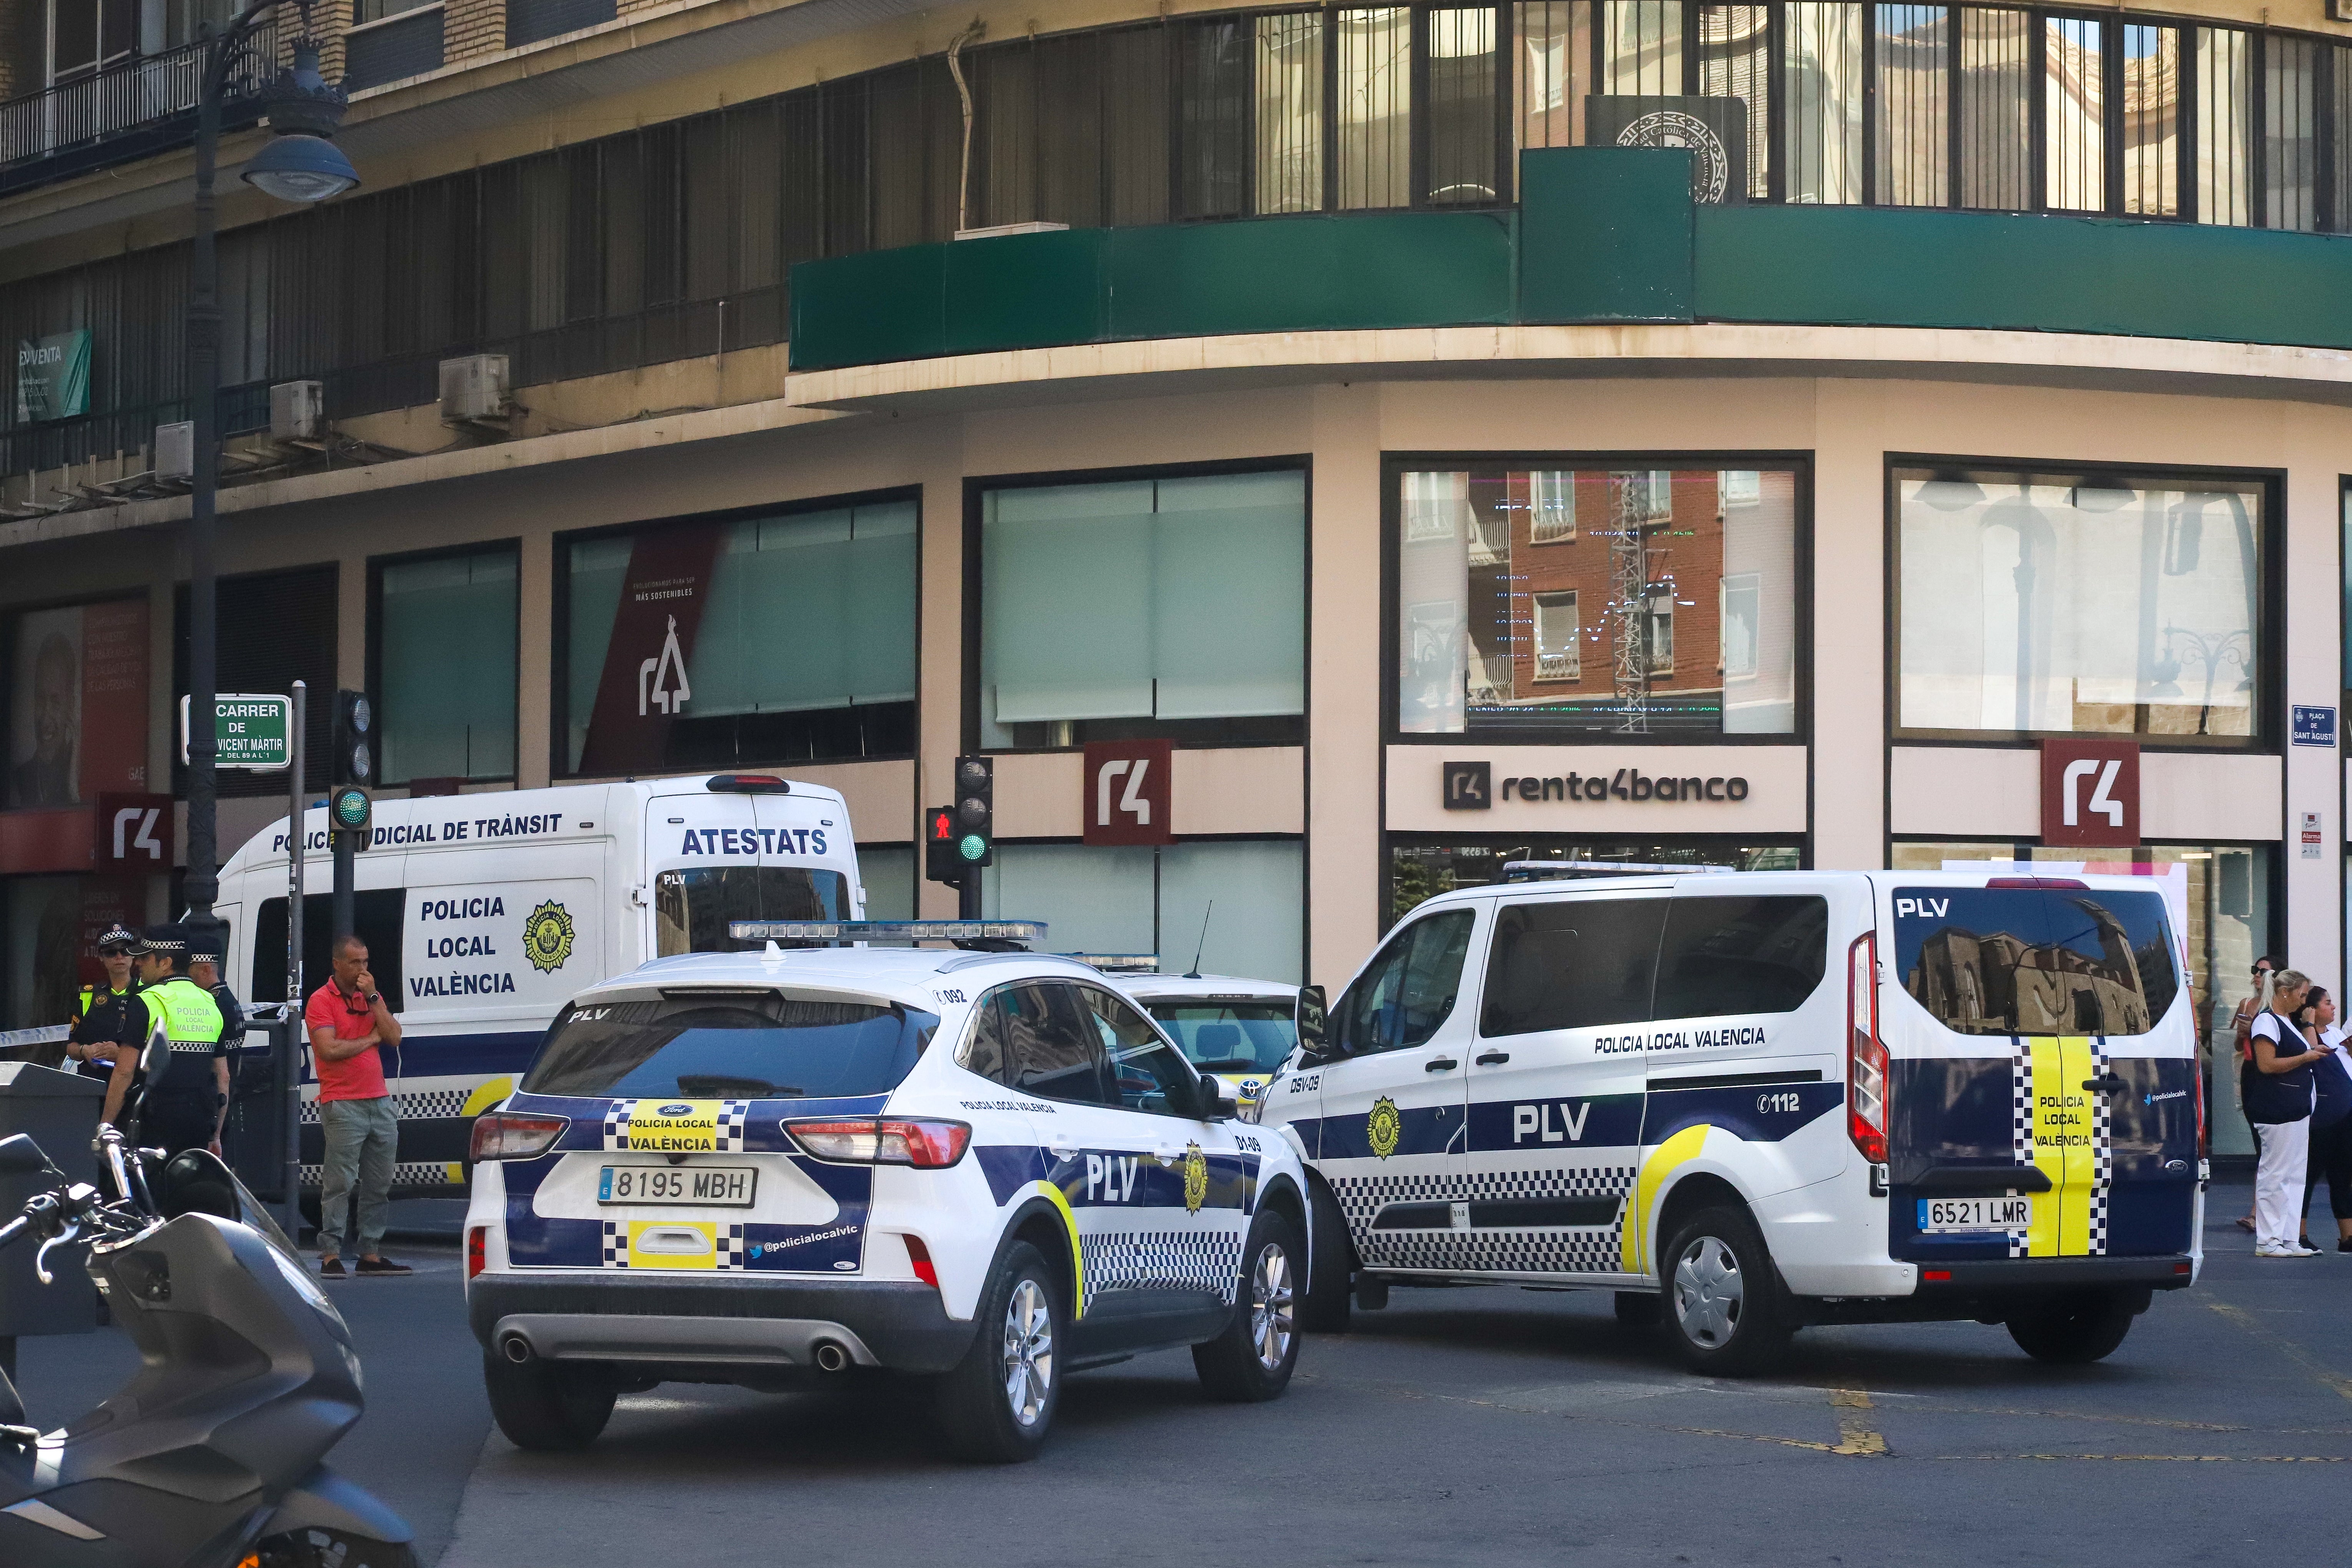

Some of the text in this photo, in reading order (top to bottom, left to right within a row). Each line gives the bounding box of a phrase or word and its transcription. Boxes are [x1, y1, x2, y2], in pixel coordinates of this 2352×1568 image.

[1691, 136, 1701, 147] de
[31, 346, 62, 365] VENTA
[636, 588, 693, 601] MÁS SOSTENIBLES
[216, 705, 278, 717] CARRER
[228, 722, 246, 733] DE
[217, 735, 283, 751] VICENT MÀRTIR
[1502, 768, 1749, 801] renta4banco
[443, 821, 468, 840] DE
[474, 813, 562, 838] TRÀNSIT
[681, 829, 827, 855] ATESTATS
[663, 875, 686, 885] PLV
[421, 897, 505, 921] POLICIA
[1896, 898, 1949, 918] PLV
[533, 913, 565, 933] POLICIA LOCAL
[428, 936, 496, 958] LOCAL
[410, 971, 515, 997] VALÈNCIA
[943, 989, 967, 1003] 092
[176, 1008, 210, 1016] POLICIA
[568, 1009, 611, 1023] PLV
[176, 1023, 213, 1033] VALÈNCIA
[1595, 1027, 1765, 1054] POLICIA LOCAL VALENCIA
[1290, 1075, 1319, 1093] DSV-09
[1770, 1093, 1800, 1112] 112
[2040, 1096, 2084, 1107] POLICIA
[2152, 1091, 2186, 1101] @policialocalvlc
[663, 1104, 686, 1114] Ford
[959, 1101, 1057, 1114] POLICIA LOCAL VALENCIA
[628, 1119, 713, 1128] POLICIA LOCAL
[1514, 1102, 1591, 1143] PLV
[2044, 1114, 2081, 1125] LOCAL
[630, 1136, 711, 1150] VALÈNCIA
[1235, 1136, 1261, 1152] D1-09
[2035, 1133, 2090, 1146] VALÈNCIA
[618, 1172, 682, 1197] 8195
[693, 1173, 744, 1198] MBH
[1086, 1154, 1138, 1202] PLV
[1933, 1202, 1980, 1224] 6521
[1990, 1202, 2027, 1223] LMR
[764, 1225, 858, 1252] @policialocalvlc
